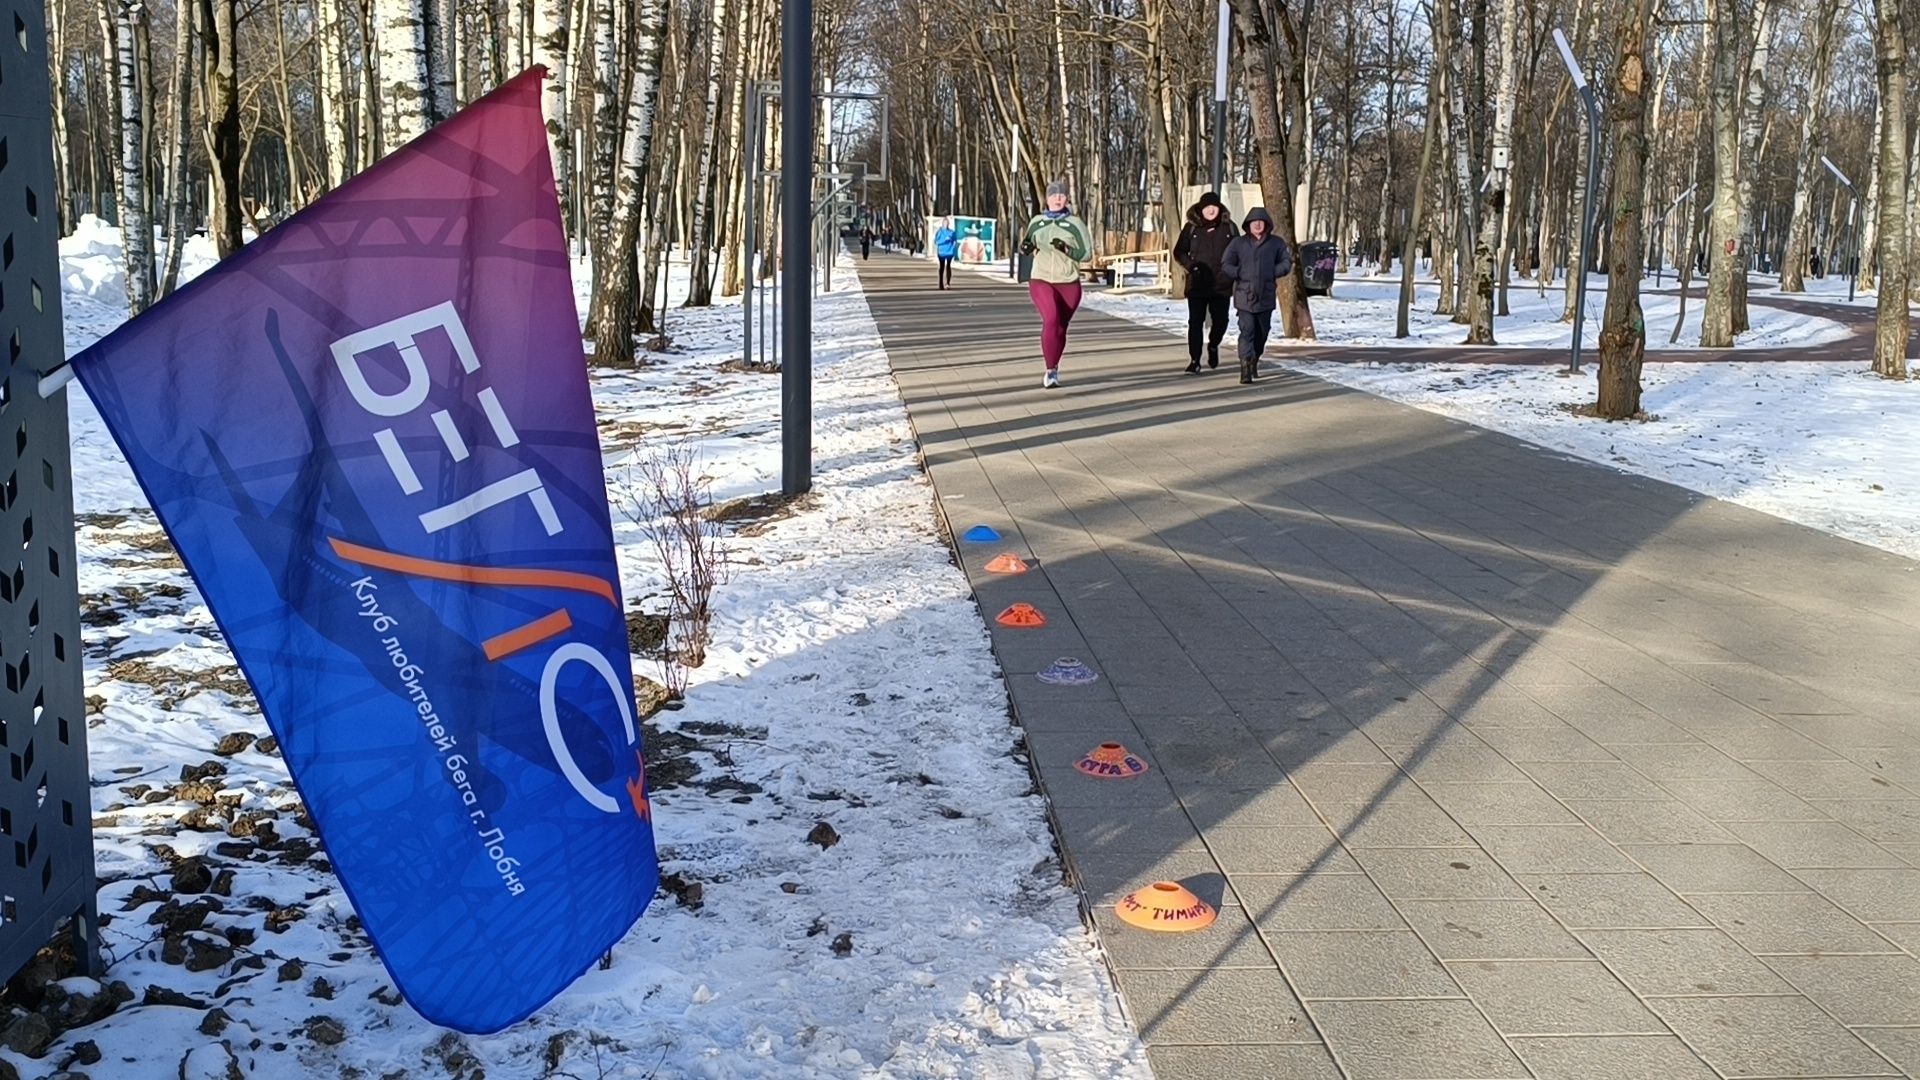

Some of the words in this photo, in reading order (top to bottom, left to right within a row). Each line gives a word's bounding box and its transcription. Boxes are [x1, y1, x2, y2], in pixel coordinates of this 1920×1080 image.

[351, 575, 398, 633] Клуб
[382, 636, 457, 752] любителей
[446, 753, 478, 807] бега
[470, 808, 485, 824] г.
[478, 827, 525, 897] Лобня
